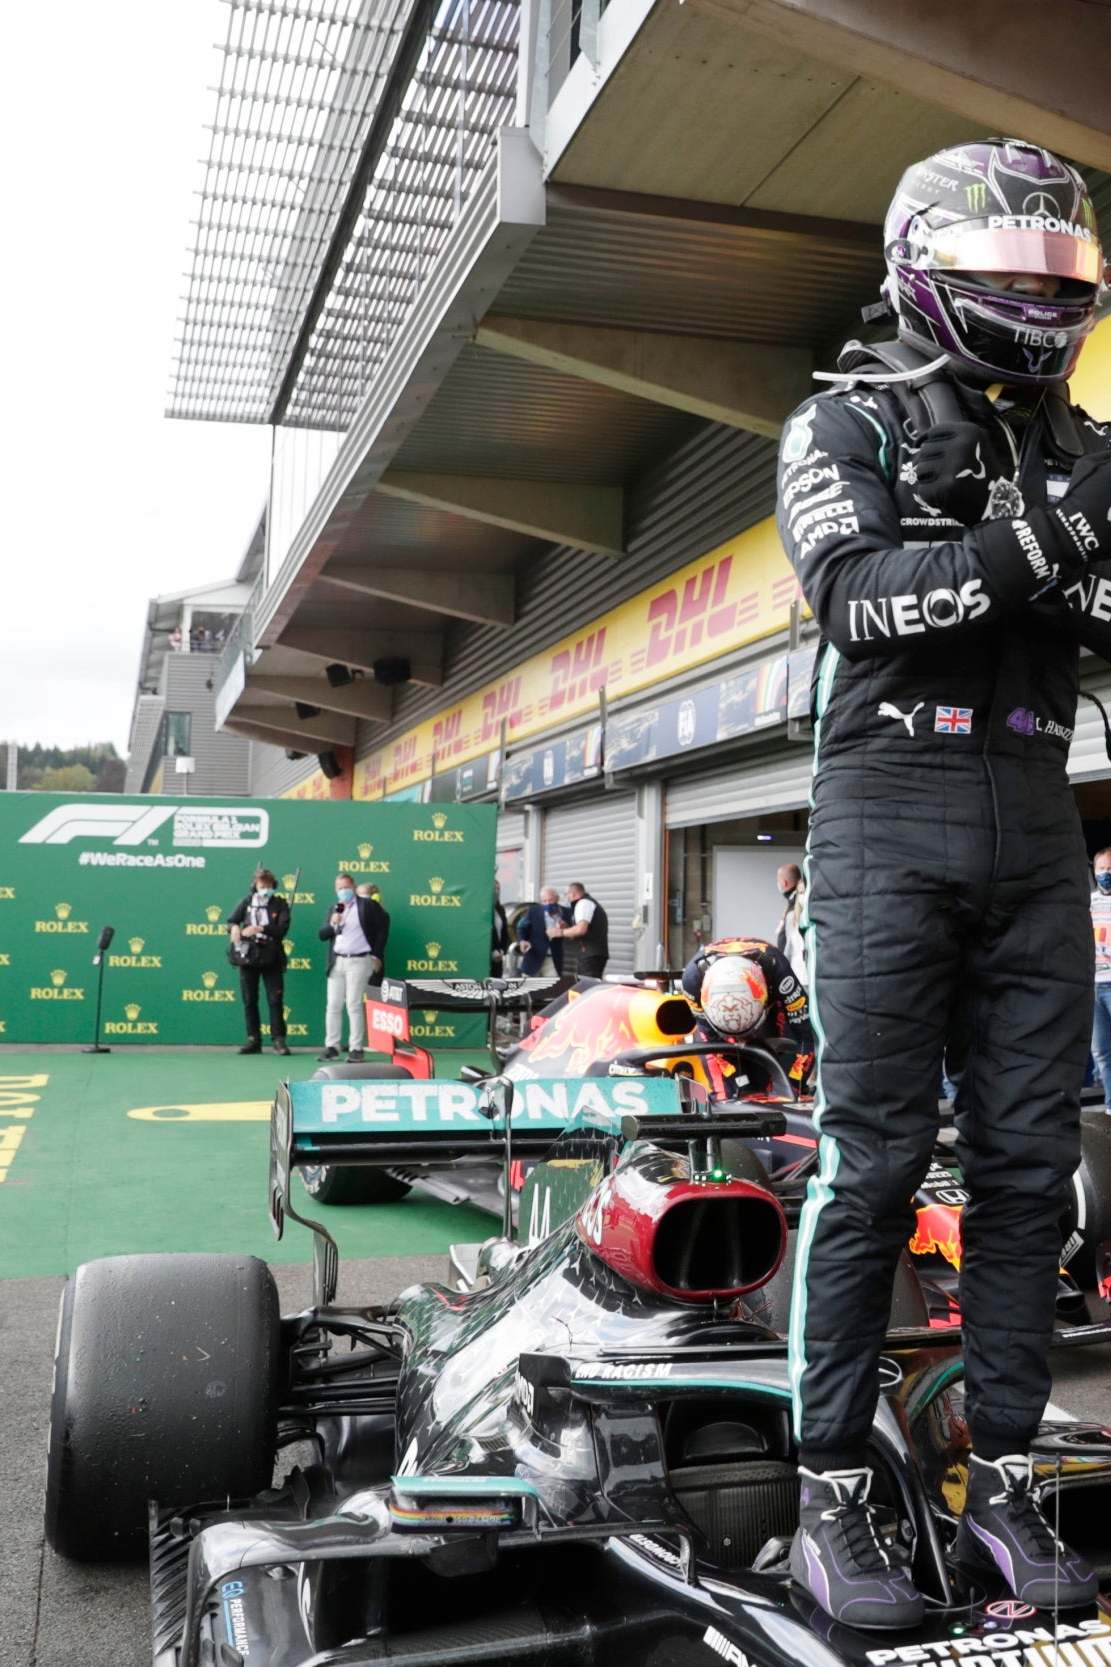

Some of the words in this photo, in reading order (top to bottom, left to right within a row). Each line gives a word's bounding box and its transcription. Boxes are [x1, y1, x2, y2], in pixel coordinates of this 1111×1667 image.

[988, 215, 1092, 243] PETRONAS
[1014, 326, 1068, 348] TIBCO
[1068, 511, 1100, 551] IWC
[800, 520, 839, 560] AMD
[647, 556, 736, 669] DHL
[847, 578, 991, 641] INEOS
[549, 627, 607, 711] DHL
[413, 829, 464, 842] ROLEX
[79, 851, 206, 868] #WeRaceAsOne
[338, 860, 391, 873] ROLEX
[409, 894, 462, 907] ROLEX
[35, 921, 89, 933] ROLEX
[186, 924, 228, 935] ROLE
[108, 955, 162, 967] ROLEX
[406, 959, 459, 972] ROLEX
[31, 987, 84, 999] ROLEX
[182, 989, 236, 1001] ROLEX
[105, 1022, 158, 1034] ROLEX
[372, 1009, 404, 1036] ESSO
[602, 1363, 673, 1378] RACISM
[865, 1619, 1111, 1666] PETRONAS
